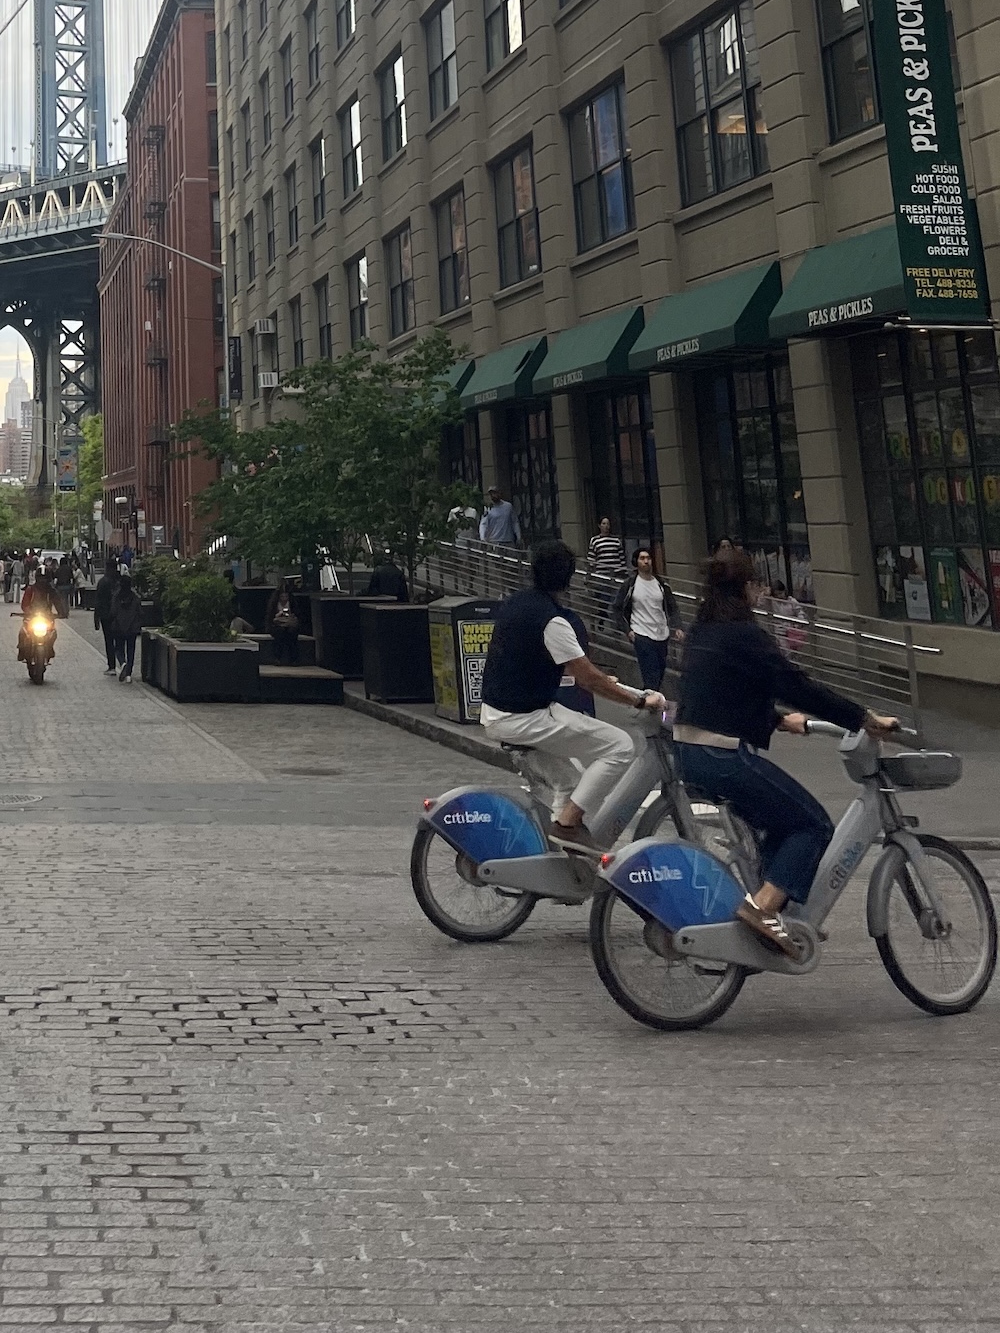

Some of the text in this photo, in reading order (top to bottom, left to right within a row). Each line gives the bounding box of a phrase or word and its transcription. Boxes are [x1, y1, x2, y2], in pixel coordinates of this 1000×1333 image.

[902, 57, 930, 81] &
[905, 87, 939, 153] PEAS
[931, 164, 958, 174] SUSHI
[916, 174, 960, 185] HOT FOOD
[911, 184, 961, 195] COLD FOOD
[932, 195, 962, 205] SALAD
[900, 205, 964, 215] FRESH FRUITS
[907, 215, 966, 225] VEGETABLES
[923, 225, 967, 235] FLOWERS
[939, 236, 969, 246] DELI &
[927, 246, 970, 256] GROCERY
[906, 267, 975, 278] FREE DELIVERY
[808, 297, 874, 327] PEAS & PICKLES
